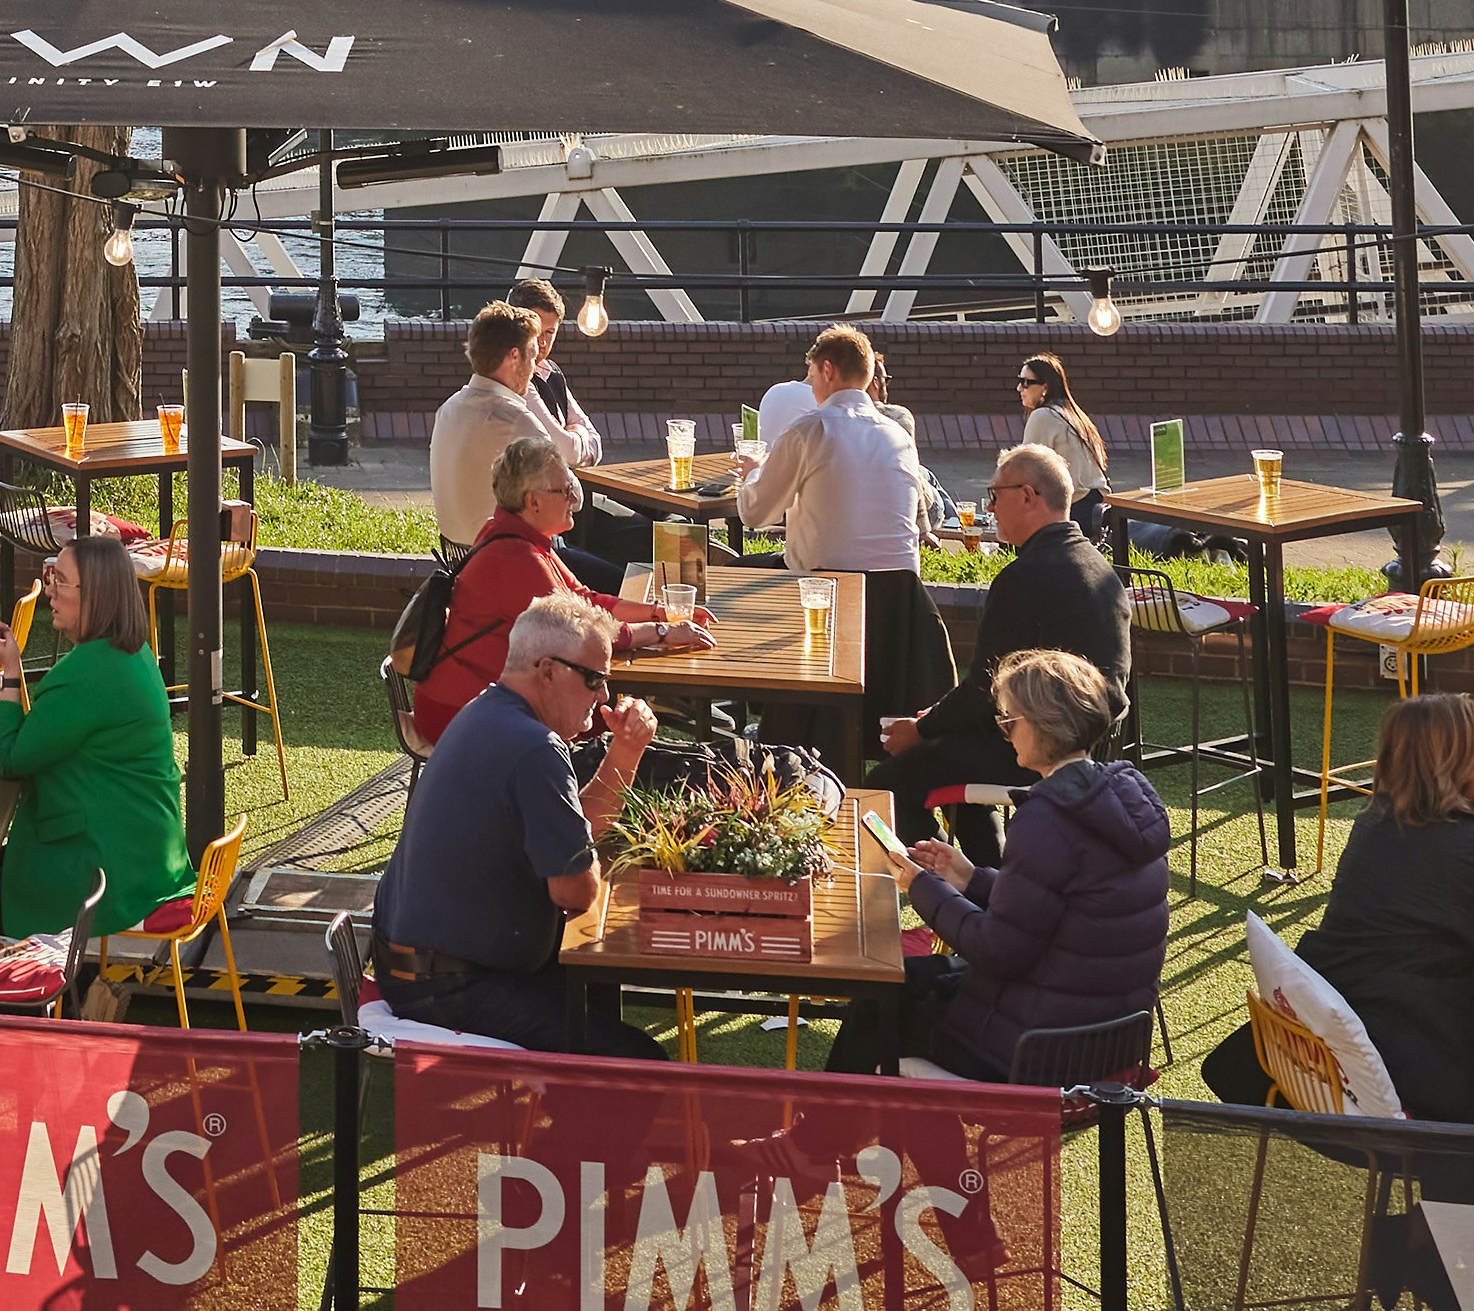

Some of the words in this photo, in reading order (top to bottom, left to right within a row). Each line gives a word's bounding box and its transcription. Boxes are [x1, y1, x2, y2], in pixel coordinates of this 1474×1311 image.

[651, 884, 671, 895] TIME
[674, 885, 693, 896] FOR
[696, 887, 703, 897] A
[704, 888, 761, 900] SUNDOWNER
[763, 891, 799, 903] SPRITZ?
[694, 928, 756, 953] PIMM'S
